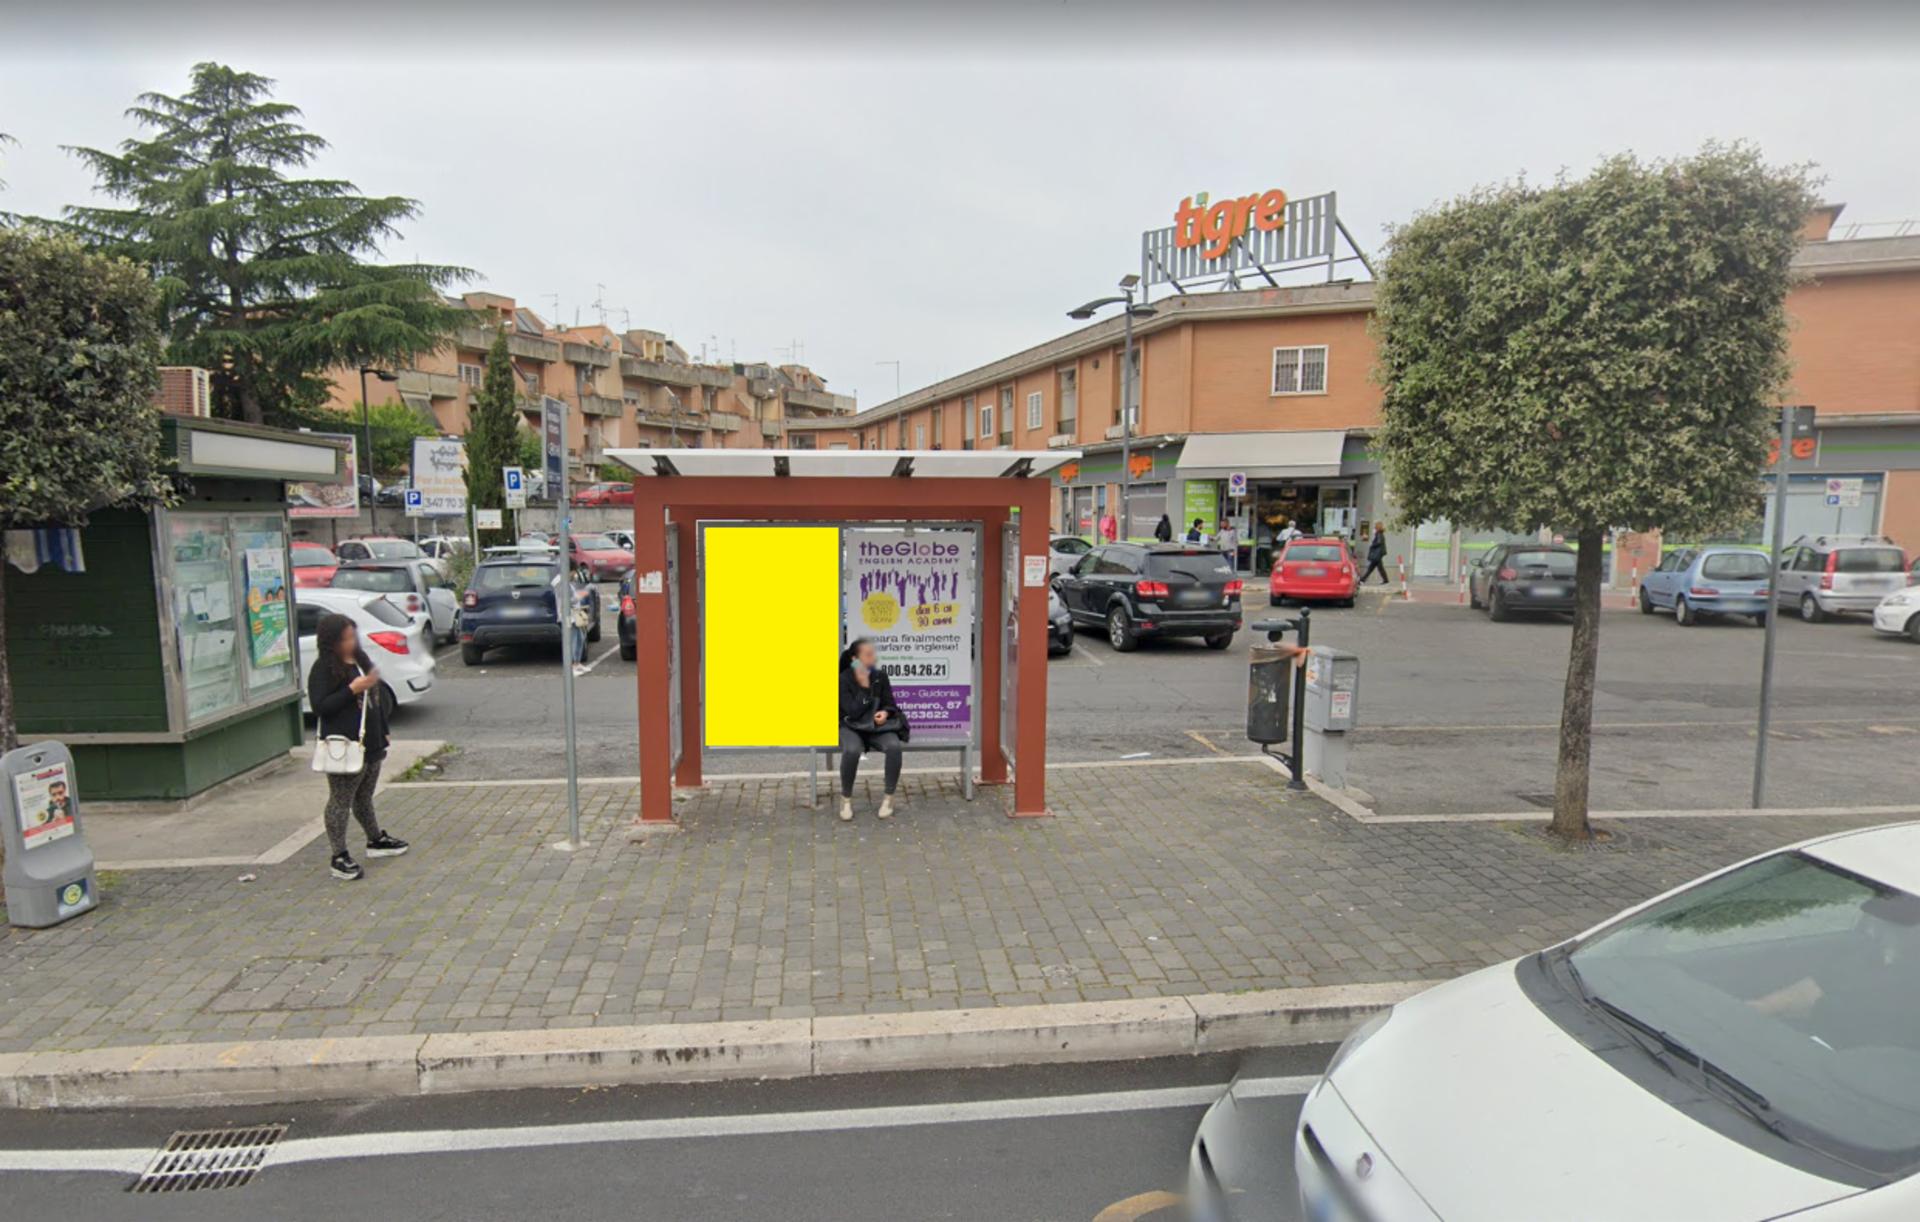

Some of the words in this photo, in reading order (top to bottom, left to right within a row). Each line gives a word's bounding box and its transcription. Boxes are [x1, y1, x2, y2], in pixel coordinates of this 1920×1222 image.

[1174, 188, 1288, 260] tigre
[859, 541, 960, 556] theGlobe
[859, 557, 903, 565] ENGLISH
[901, 634, 961, 643] finalmente
[878, 644, 912, 652] arlare
[915, 643, 959, 653] inglese!
[918, 689, 960, 698] Guidonia
[946, 701, 962, 710] 87
